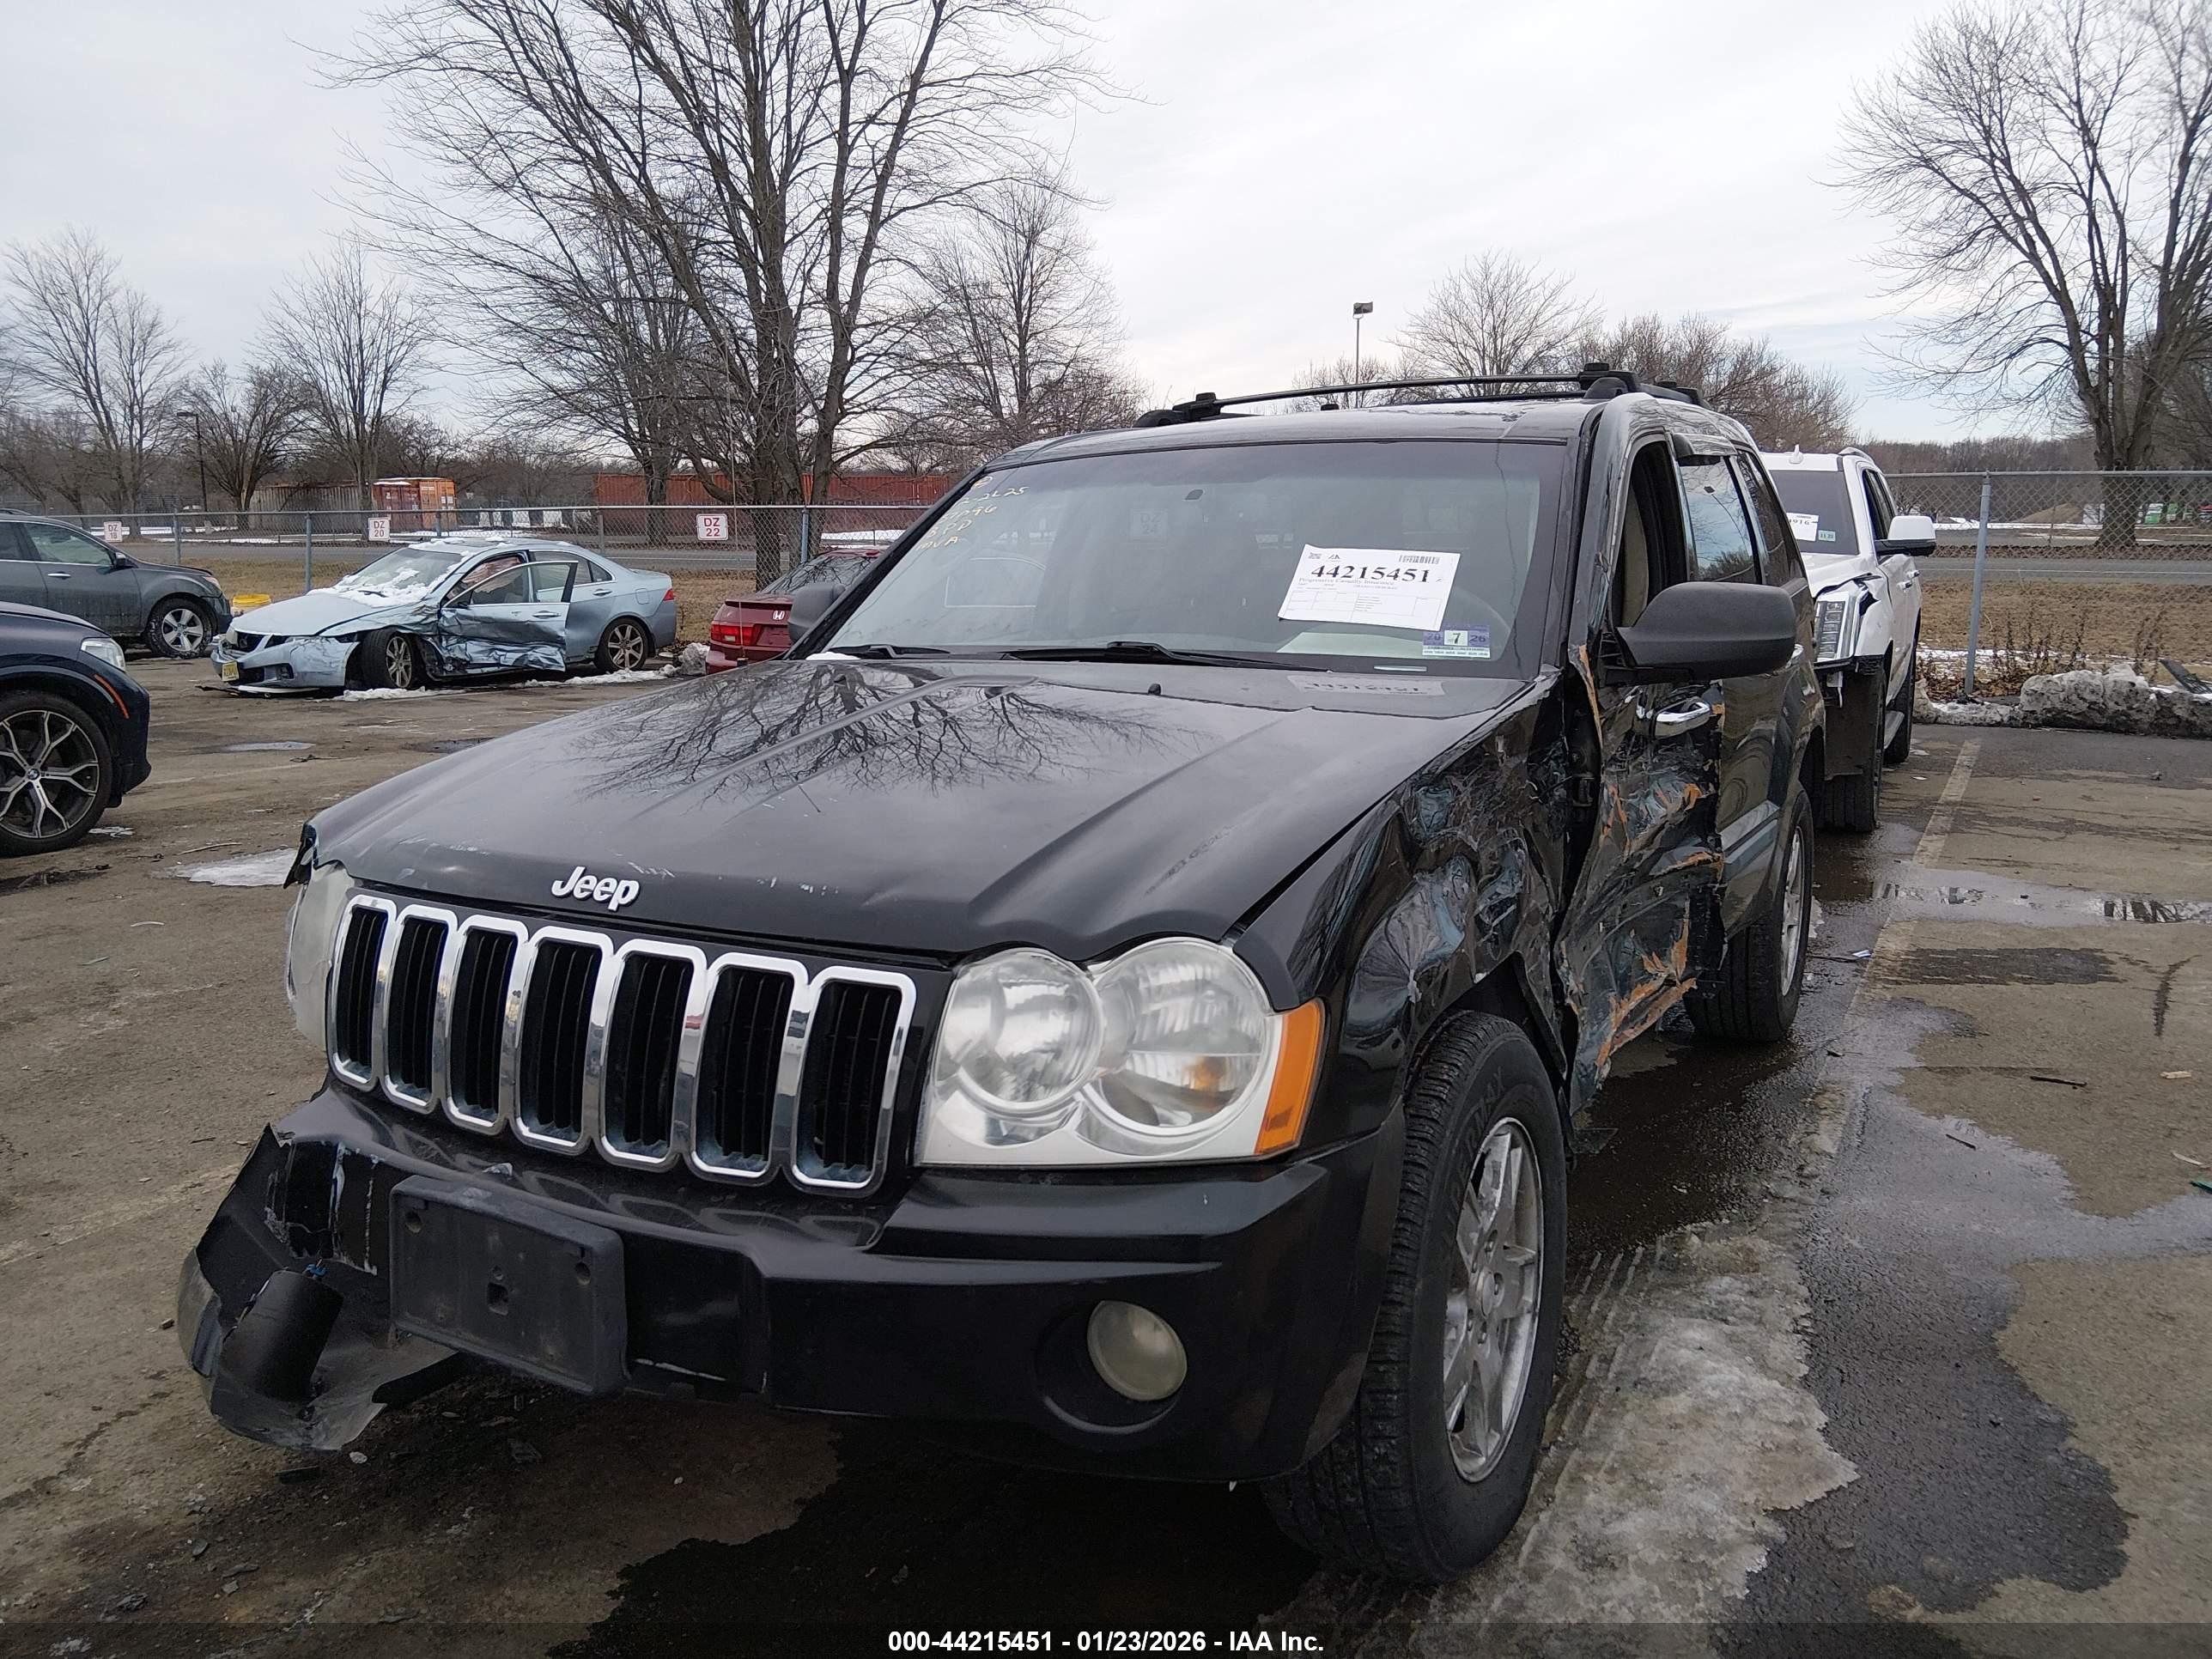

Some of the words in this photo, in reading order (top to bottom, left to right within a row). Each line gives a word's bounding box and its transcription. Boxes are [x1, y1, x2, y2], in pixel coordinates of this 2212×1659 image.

[374, 520, 385, 529] DZ
[704, 518, 720, 527] DZ
[706, 528, 720, 537] 22
[1311, 565, 1429, 582] 44215451
[1453, 633, 1462, 644] 7
[1469, 635, 1486, 643] 26
[551, 866, 640, 911] Jeep
